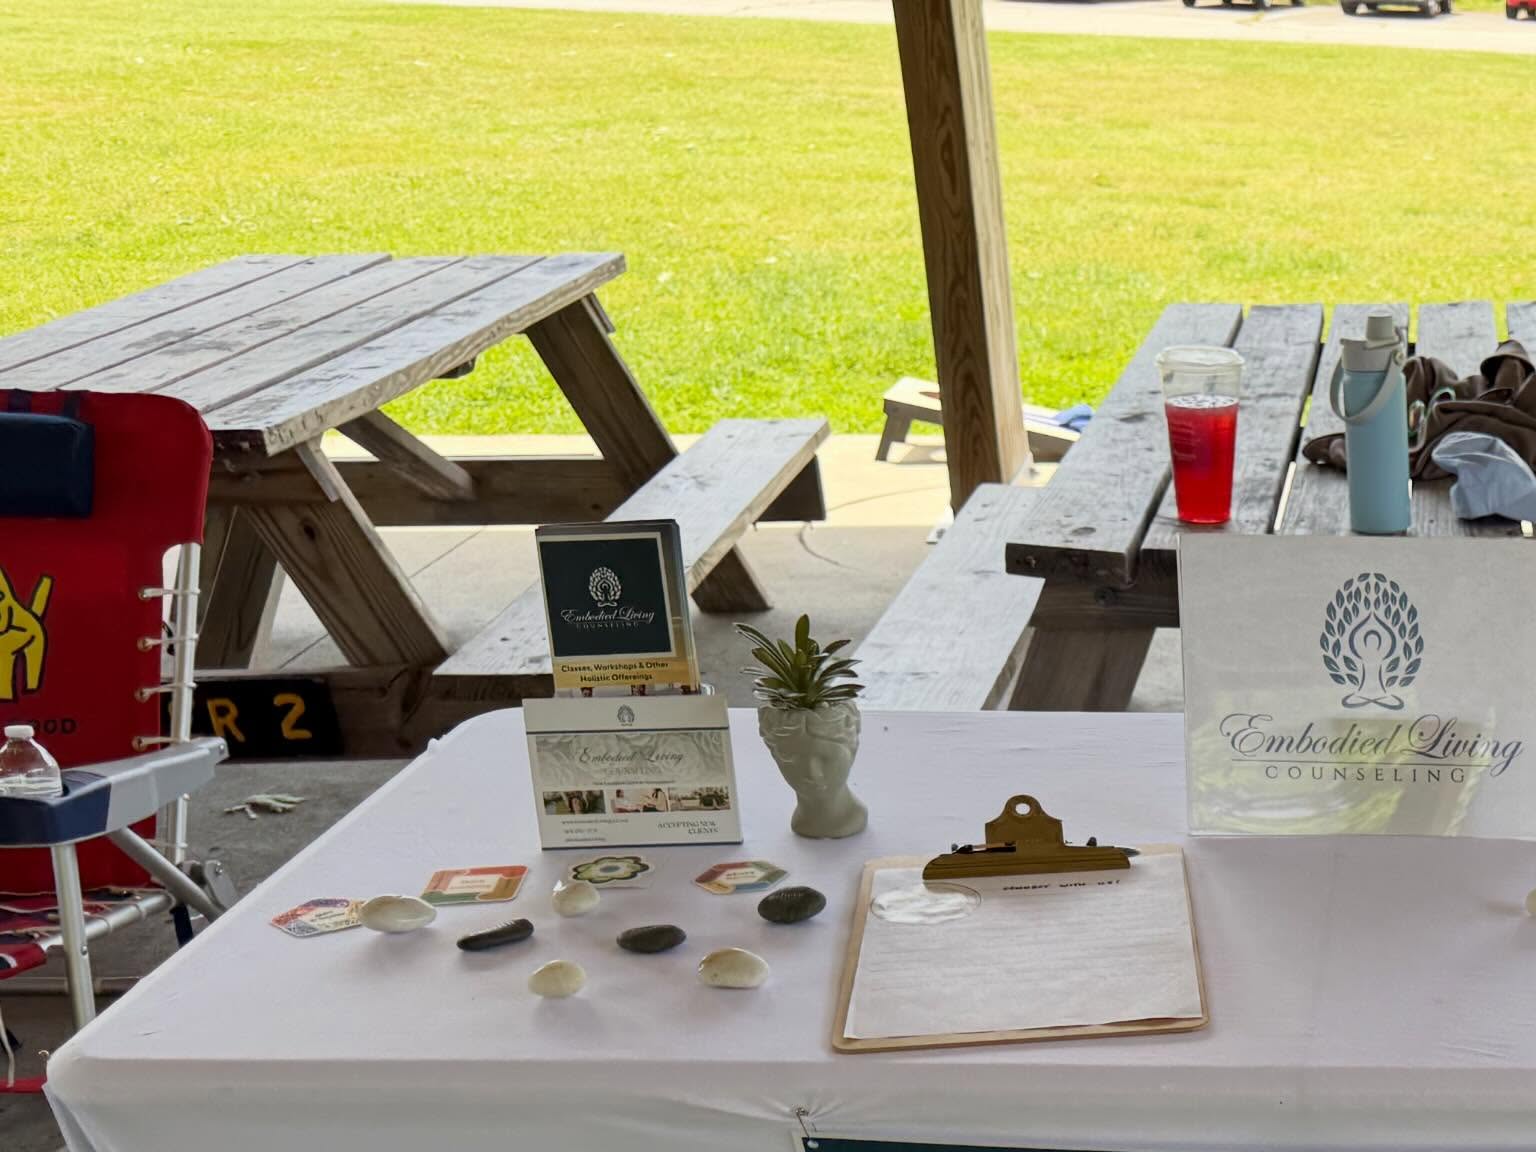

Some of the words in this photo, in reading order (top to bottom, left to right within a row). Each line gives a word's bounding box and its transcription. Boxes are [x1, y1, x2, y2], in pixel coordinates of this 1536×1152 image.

[560, 608, 617, 623] Embodied
[617, 606, 655, 624] Living
[561, 664, 593, 674] Classes,
[593, 662, 638, 672] Workshops
[645, 660, 669, 669] Other
[580, 674, 611, 683] Holistic
[273, 693, 313, 740] 2
[1219, 712, 1403, 758] Embodied
[1400, 714, 1524, 778] Living
[578, 747, 636, 764] Embodied
[646, 750, 685, 765] Living
[1265, 765, 1466, 784] COUNSELING
